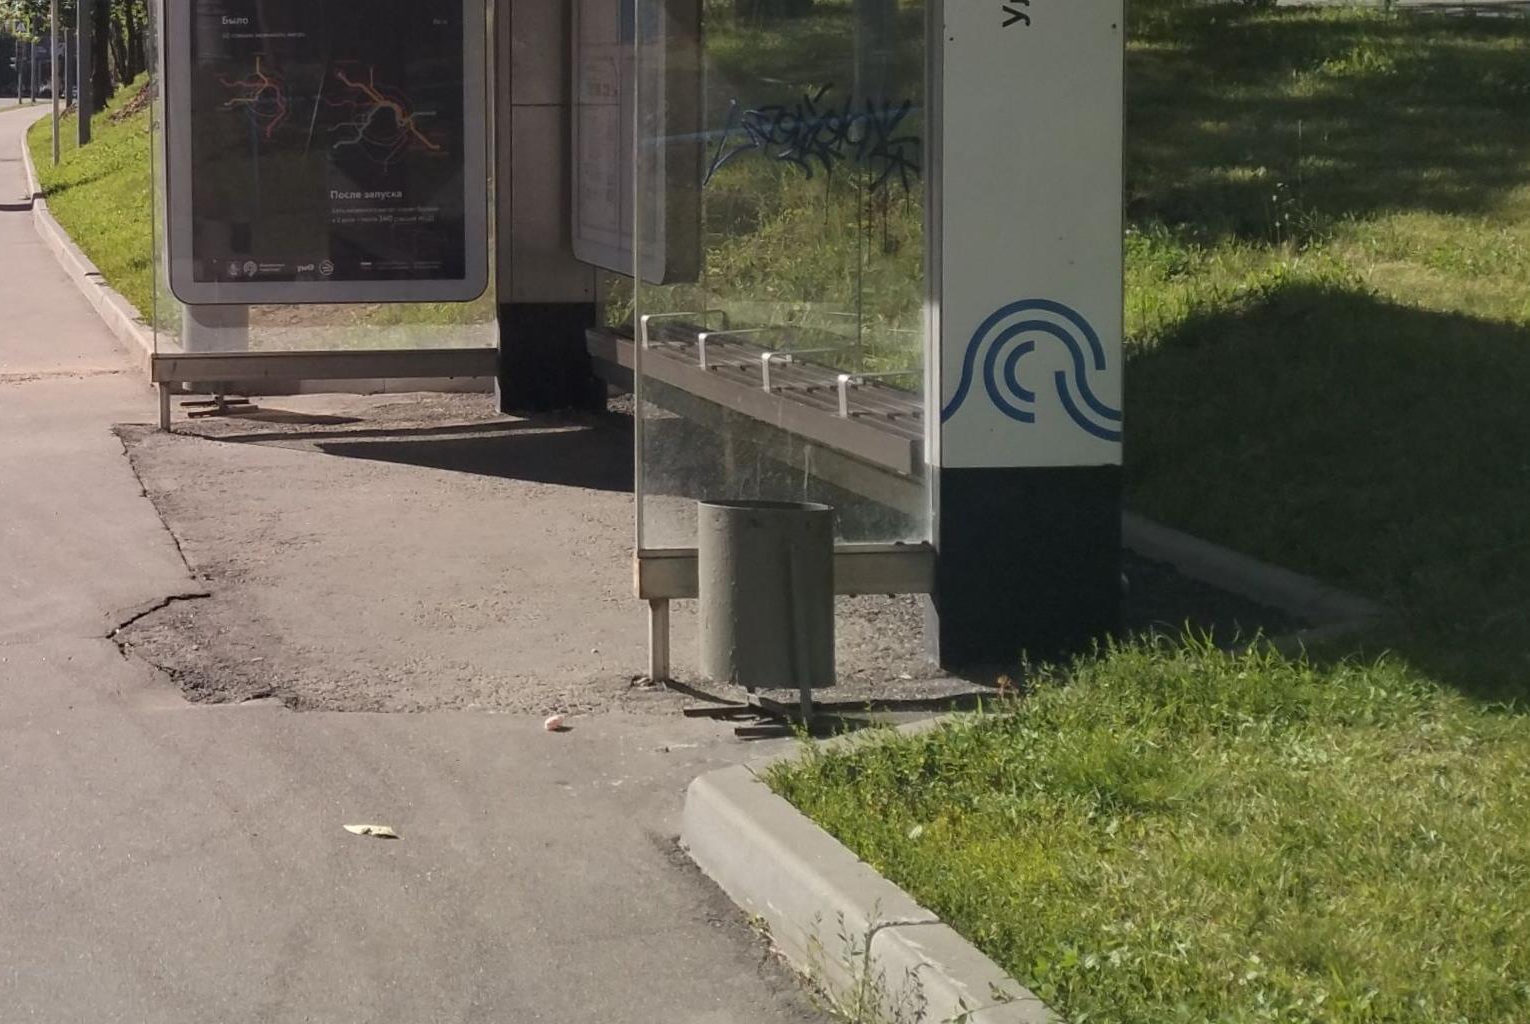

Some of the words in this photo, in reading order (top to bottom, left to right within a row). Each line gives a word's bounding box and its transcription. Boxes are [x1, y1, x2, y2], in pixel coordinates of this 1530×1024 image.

[221, 16, 249, 25] Было
[330, 190, 361, 199] После
[364, 190, 402, 201] запуска
